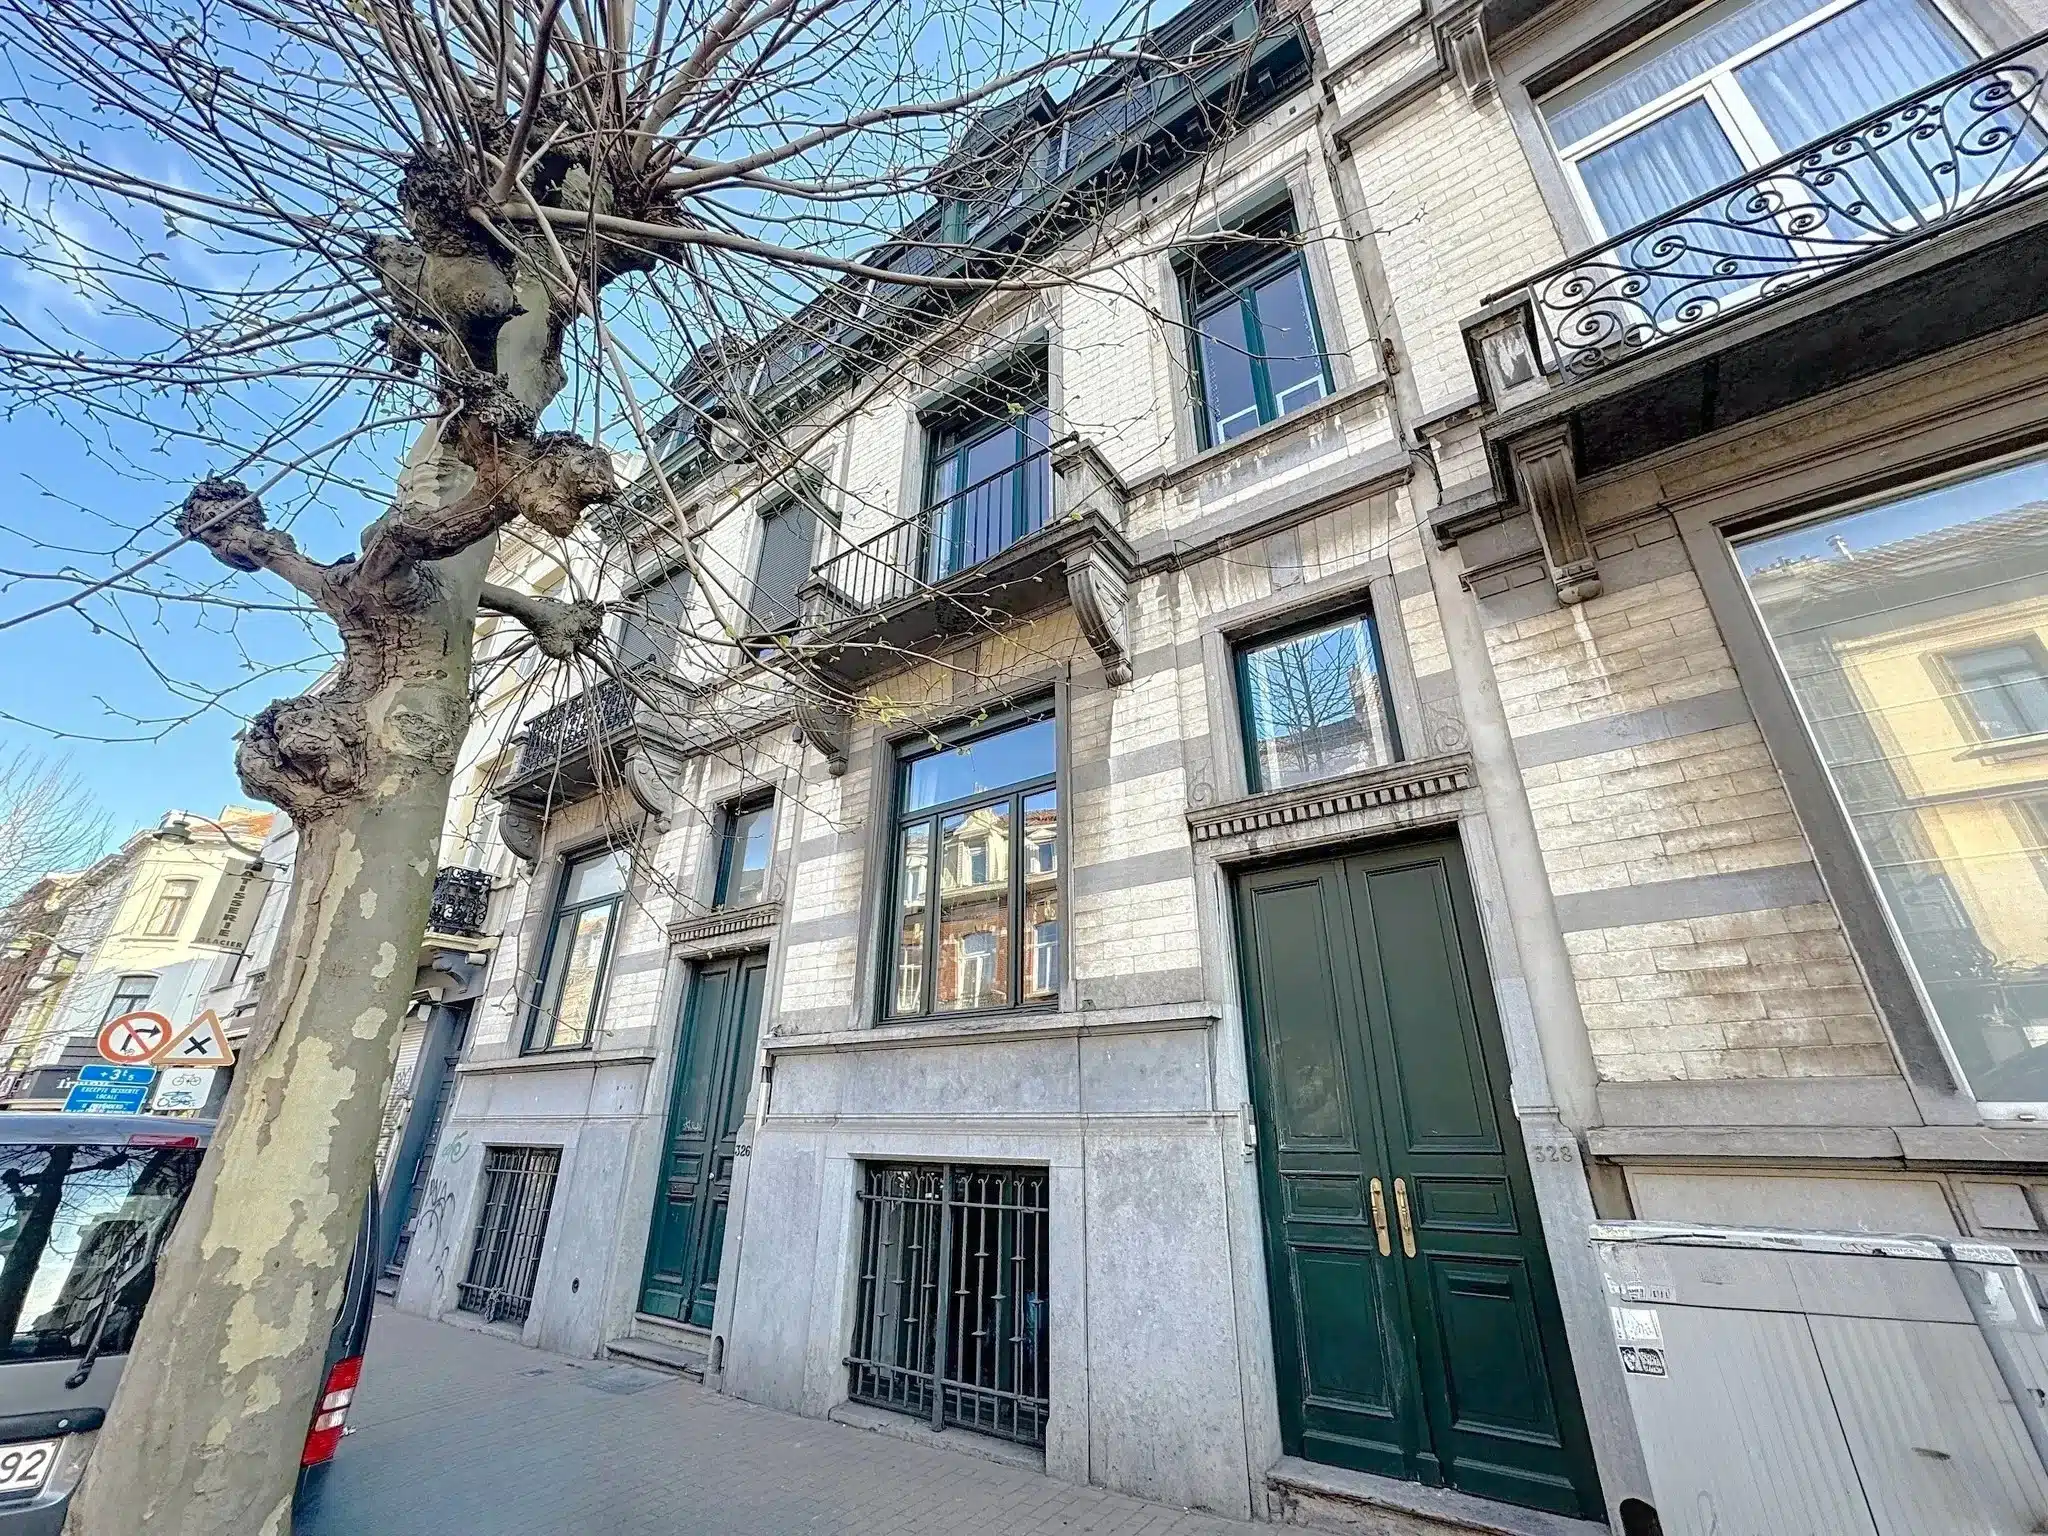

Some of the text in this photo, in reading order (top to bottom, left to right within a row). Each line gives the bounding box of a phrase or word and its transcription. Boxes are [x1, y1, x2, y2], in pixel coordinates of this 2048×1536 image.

[199, 937, 243, 948] GLACIER
[734, 1144, 751, 1157] 326
[1535, 1145, 1573, 1163] 328
[0, 1449, 47, 1484] 92
